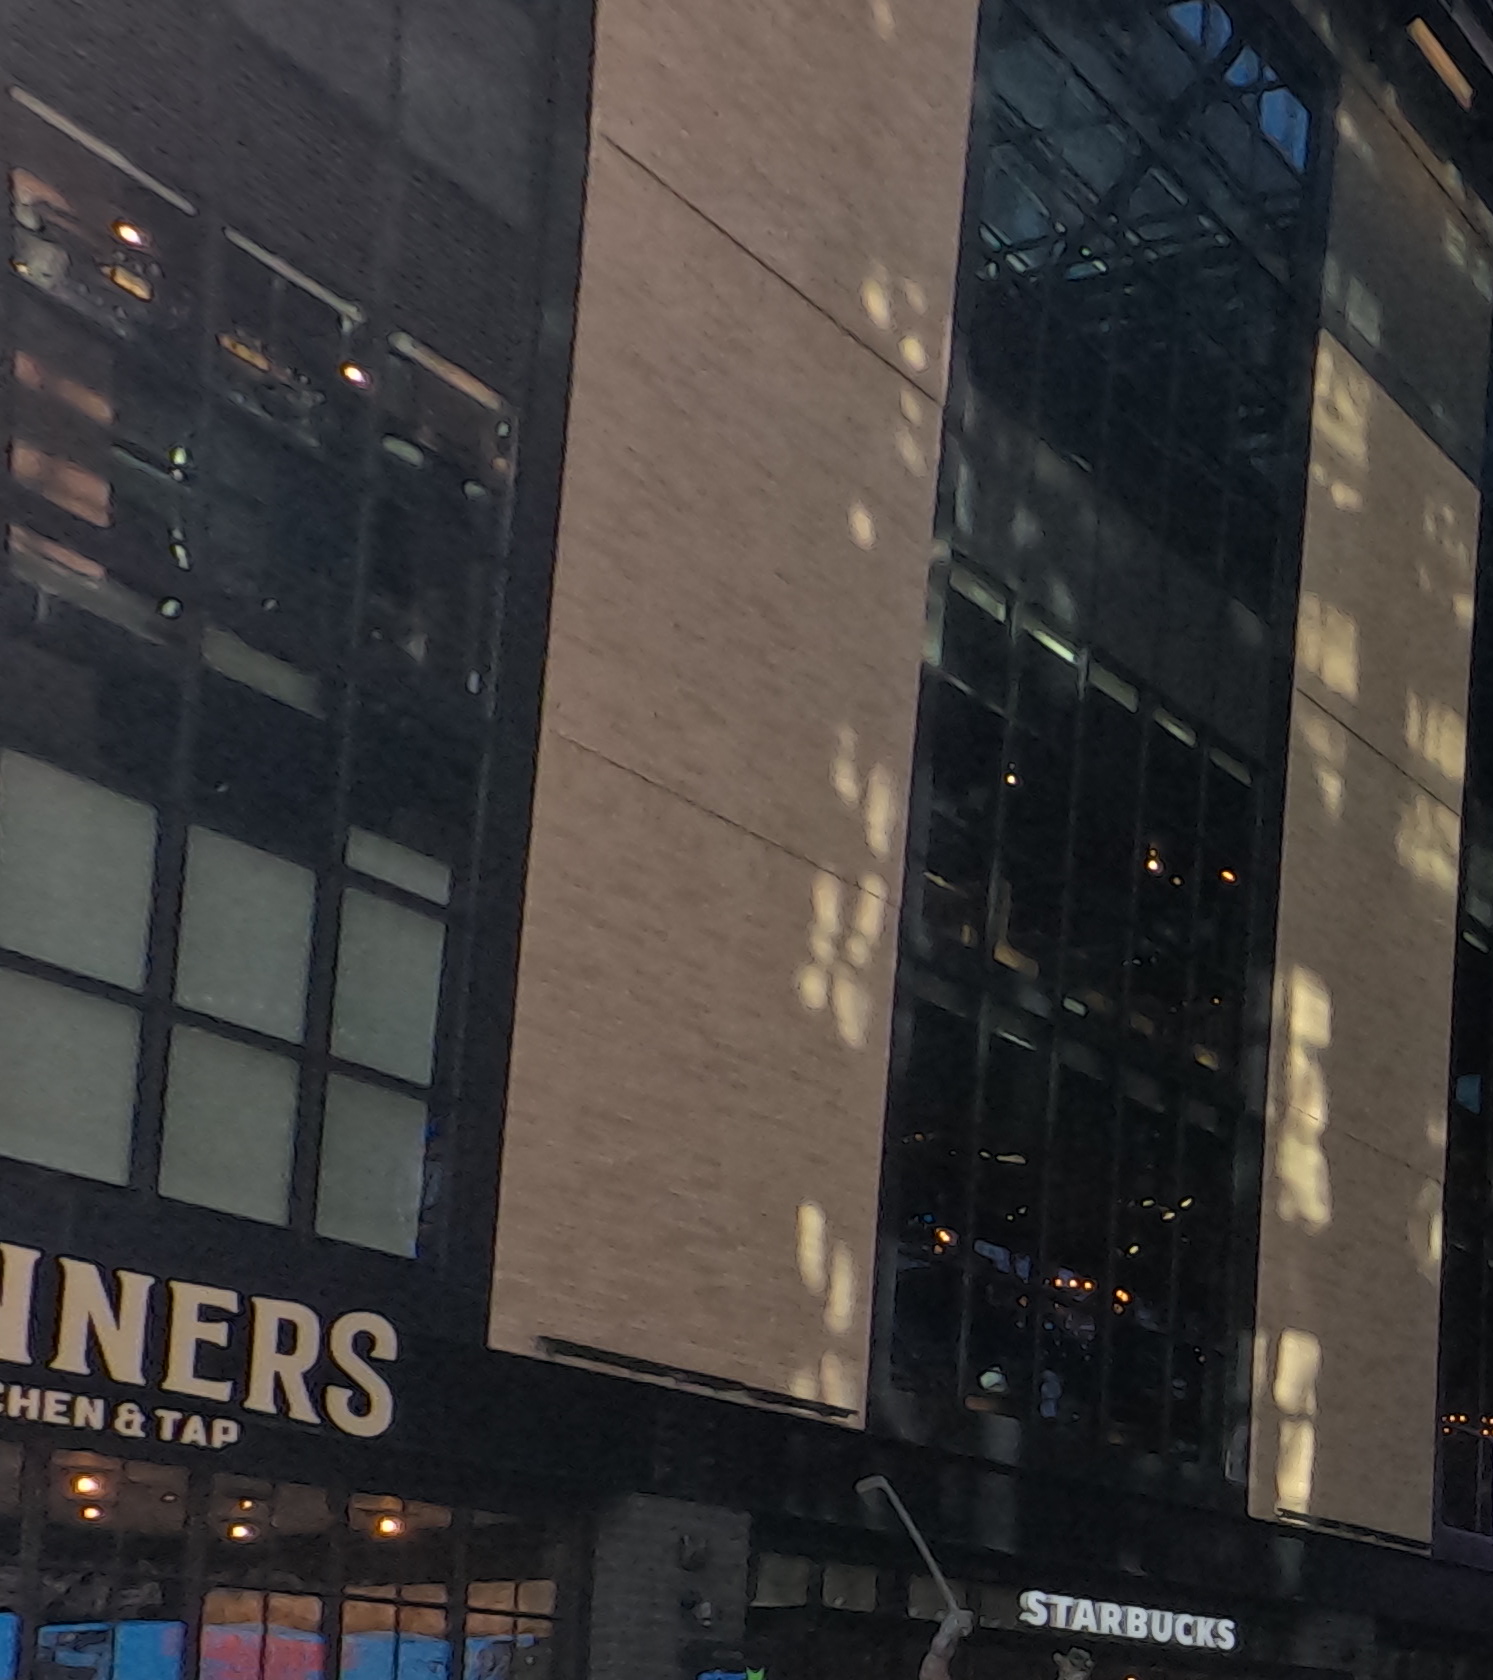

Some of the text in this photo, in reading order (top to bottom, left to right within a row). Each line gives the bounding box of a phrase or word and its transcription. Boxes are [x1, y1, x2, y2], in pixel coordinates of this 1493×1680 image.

[114, 1401, 147, 1438] &
[154, 1407, 240, 1450] TAP
[1018, 1589, 1237, 1651] STARBUCKS
